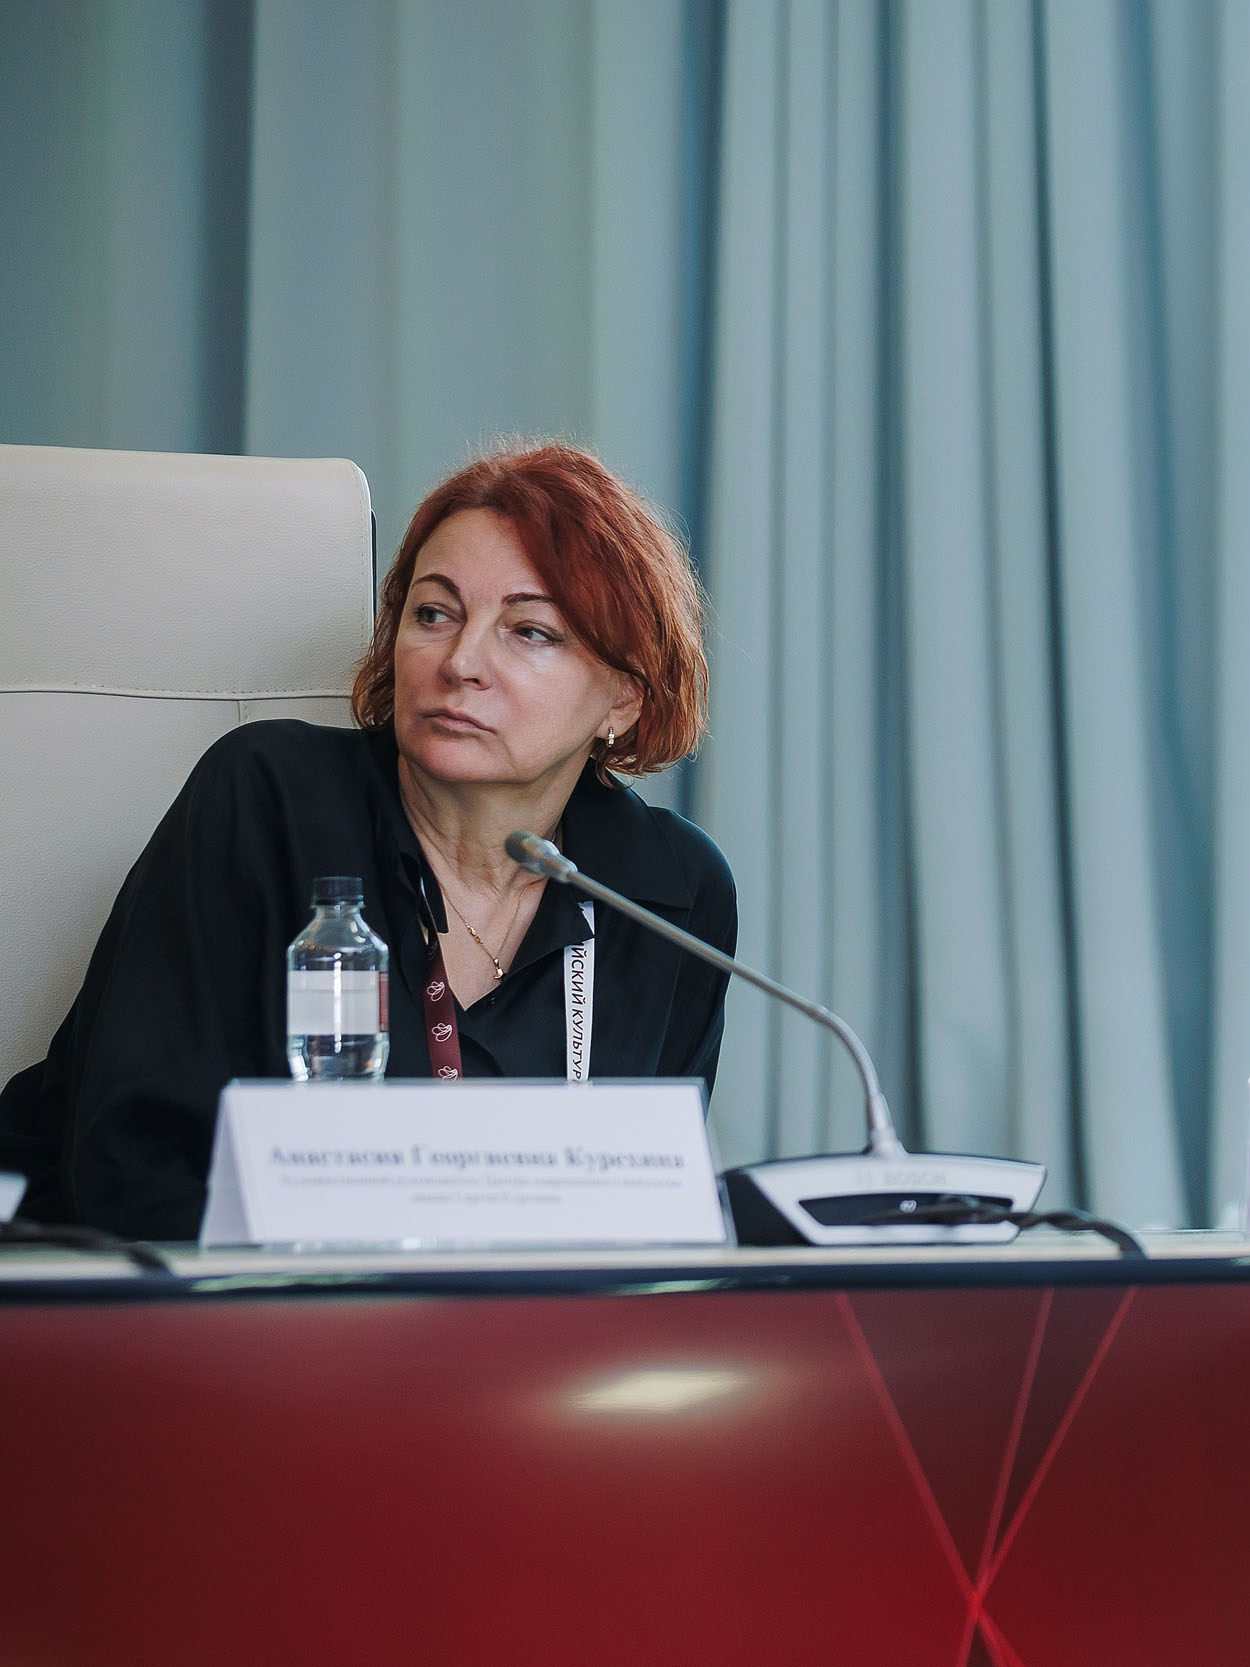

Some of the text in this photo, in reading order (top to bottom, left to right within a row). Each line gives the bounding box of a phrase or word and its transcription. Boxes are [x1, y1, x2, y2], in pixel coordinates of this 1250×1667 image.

[571, 942, 587, 1083] ЙСКИЙ КУЛЬТУР
[271, 1146, 404, 1166] Анастасия
[411, 1145, 558, 1170] Георгиевна
